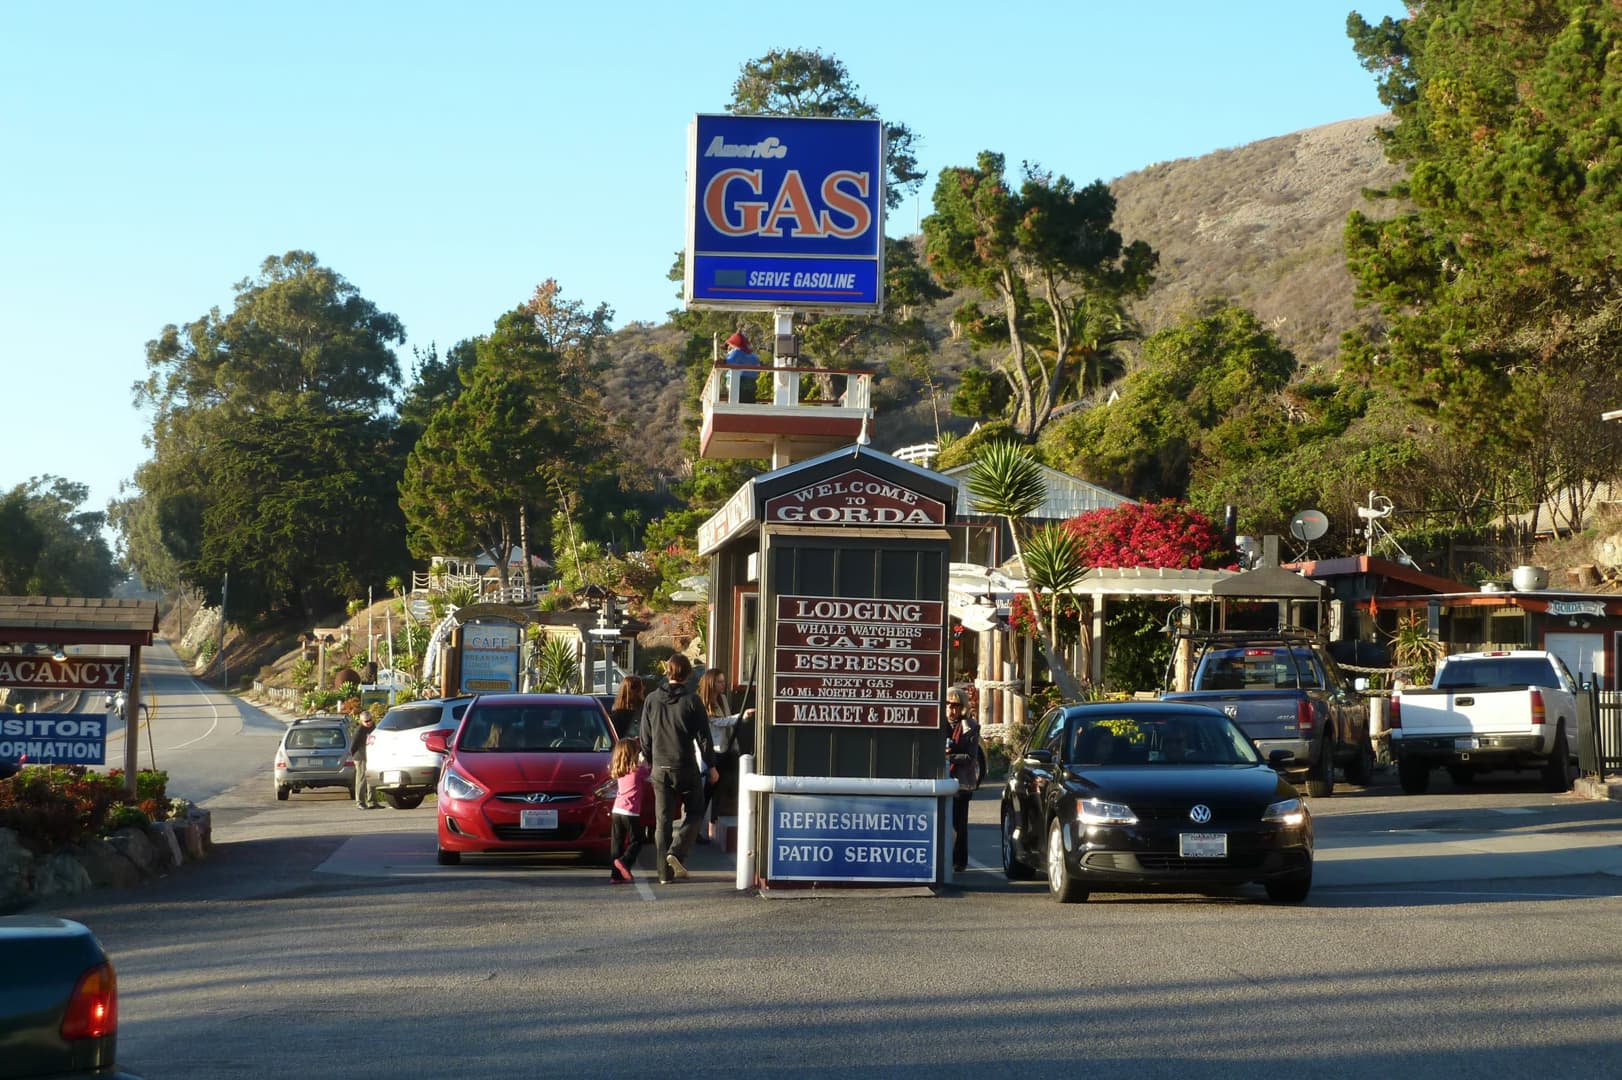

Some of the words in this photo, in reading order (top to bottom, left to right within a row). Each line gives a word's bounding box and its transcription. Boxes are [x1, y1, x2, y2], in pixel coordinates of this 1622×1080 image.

[704, 168, 871, 239] GAS
[749, 271, 791, 287] SERVE
[794, 272, 856, 289] GASOLINE
[794, 481, 919, 506] WELCOME
[845, 497, 866, 505] TO
[777, 506, 934, 524] GORDA
[796, 600, 922, 622] LODGING
[796, 624, 846, 635] WHALE
[851, 625, 922, 637] WATCHERS
[806, 635, 912, 649] CAFE
[795, 654, 920, 673] ESPRESSO
[822, 678, 862, 687] NEXT
[867, 679, 894, 688] GAS
[780, 687, 794, 696] 40
[818, 688, 857, 698] NORTH
[861, 689, 872, 698] 12
[896, 690, 934, 700] SOUTH
[793, 704, 863, 723] MARKET
[867, 706, 879, 722] &
[883, 706, 919, 724] DELI
[0, 720, 101, 737] SITOR
[778, 811, 928, 831] REFRESHMENTS
[778, 845, 833, 862] PATIO
[844, 846, 927, 864] SERVICE
